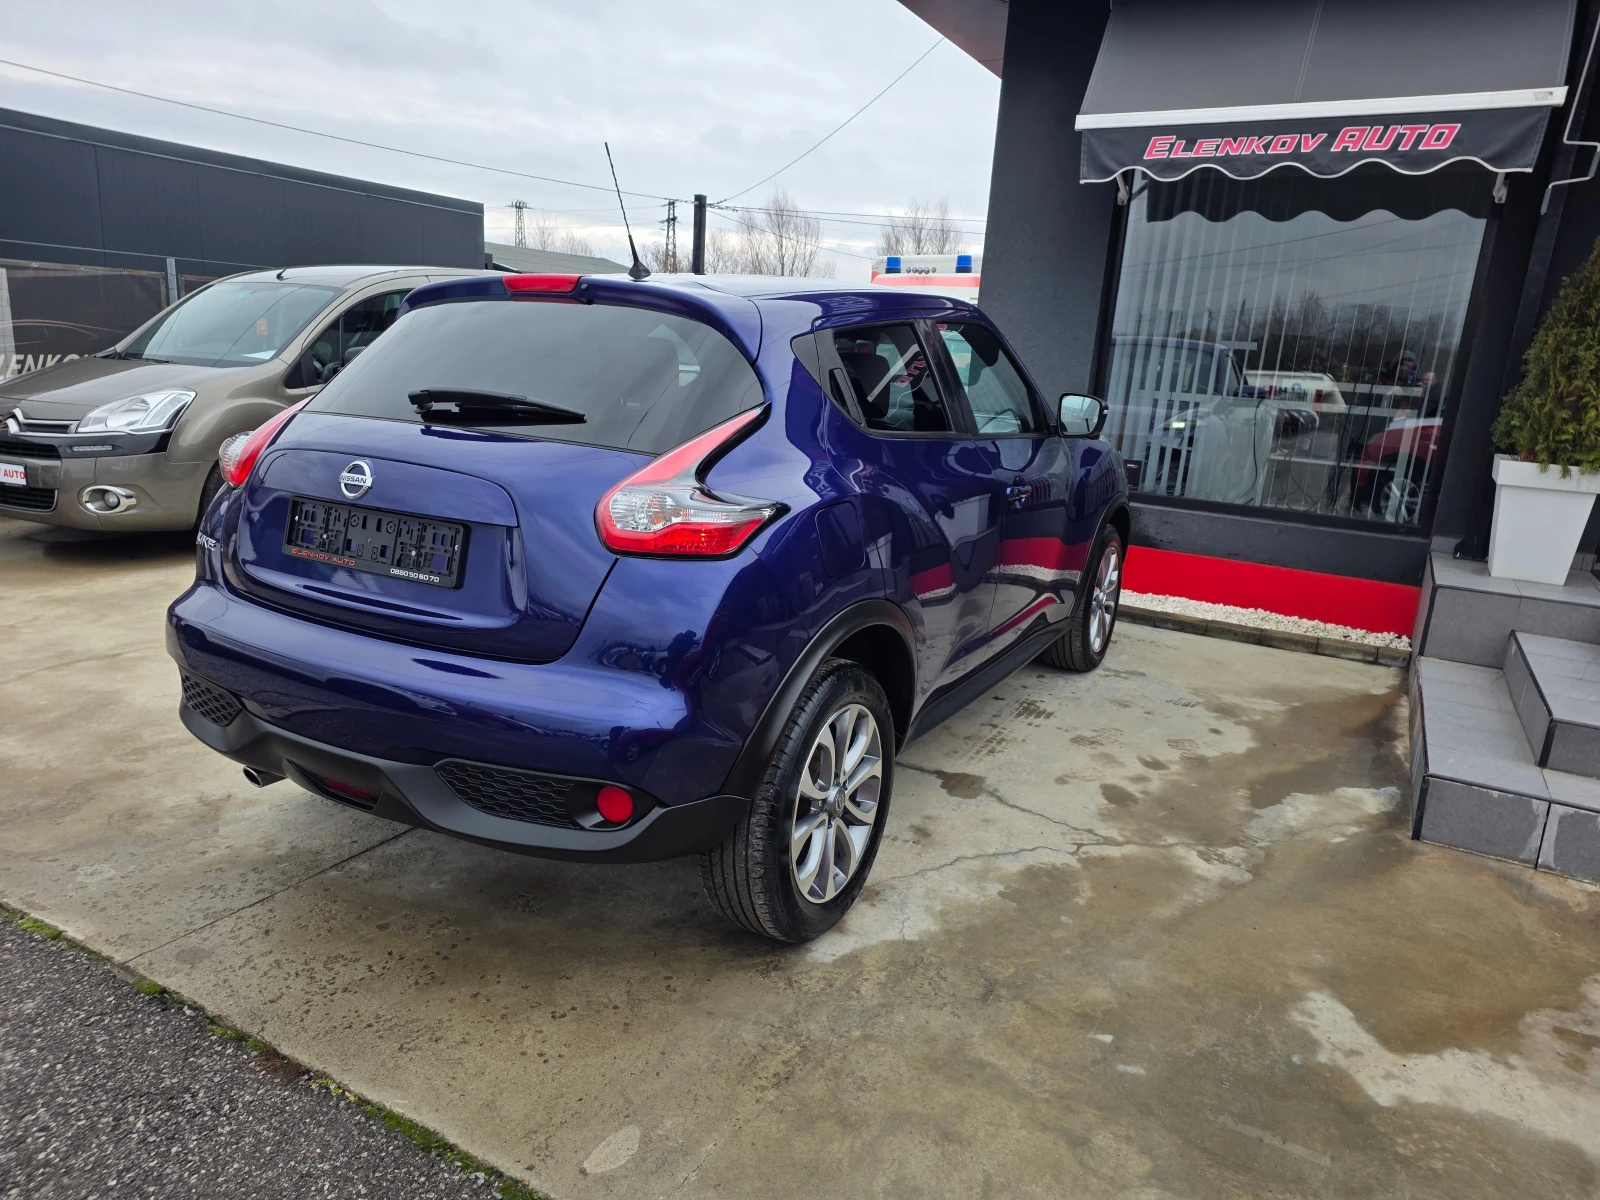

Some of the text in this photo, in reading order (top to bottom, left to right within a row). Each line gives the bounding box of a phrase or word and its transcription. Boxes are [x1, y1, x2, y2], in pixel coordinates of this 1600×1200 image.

[1330, 123, 1461, 152] AUTO
[3, 469, 27, 480] AUTO
[341, 474, 368, 485] NISSAN
[332, 556, 356, 567] AUTO
